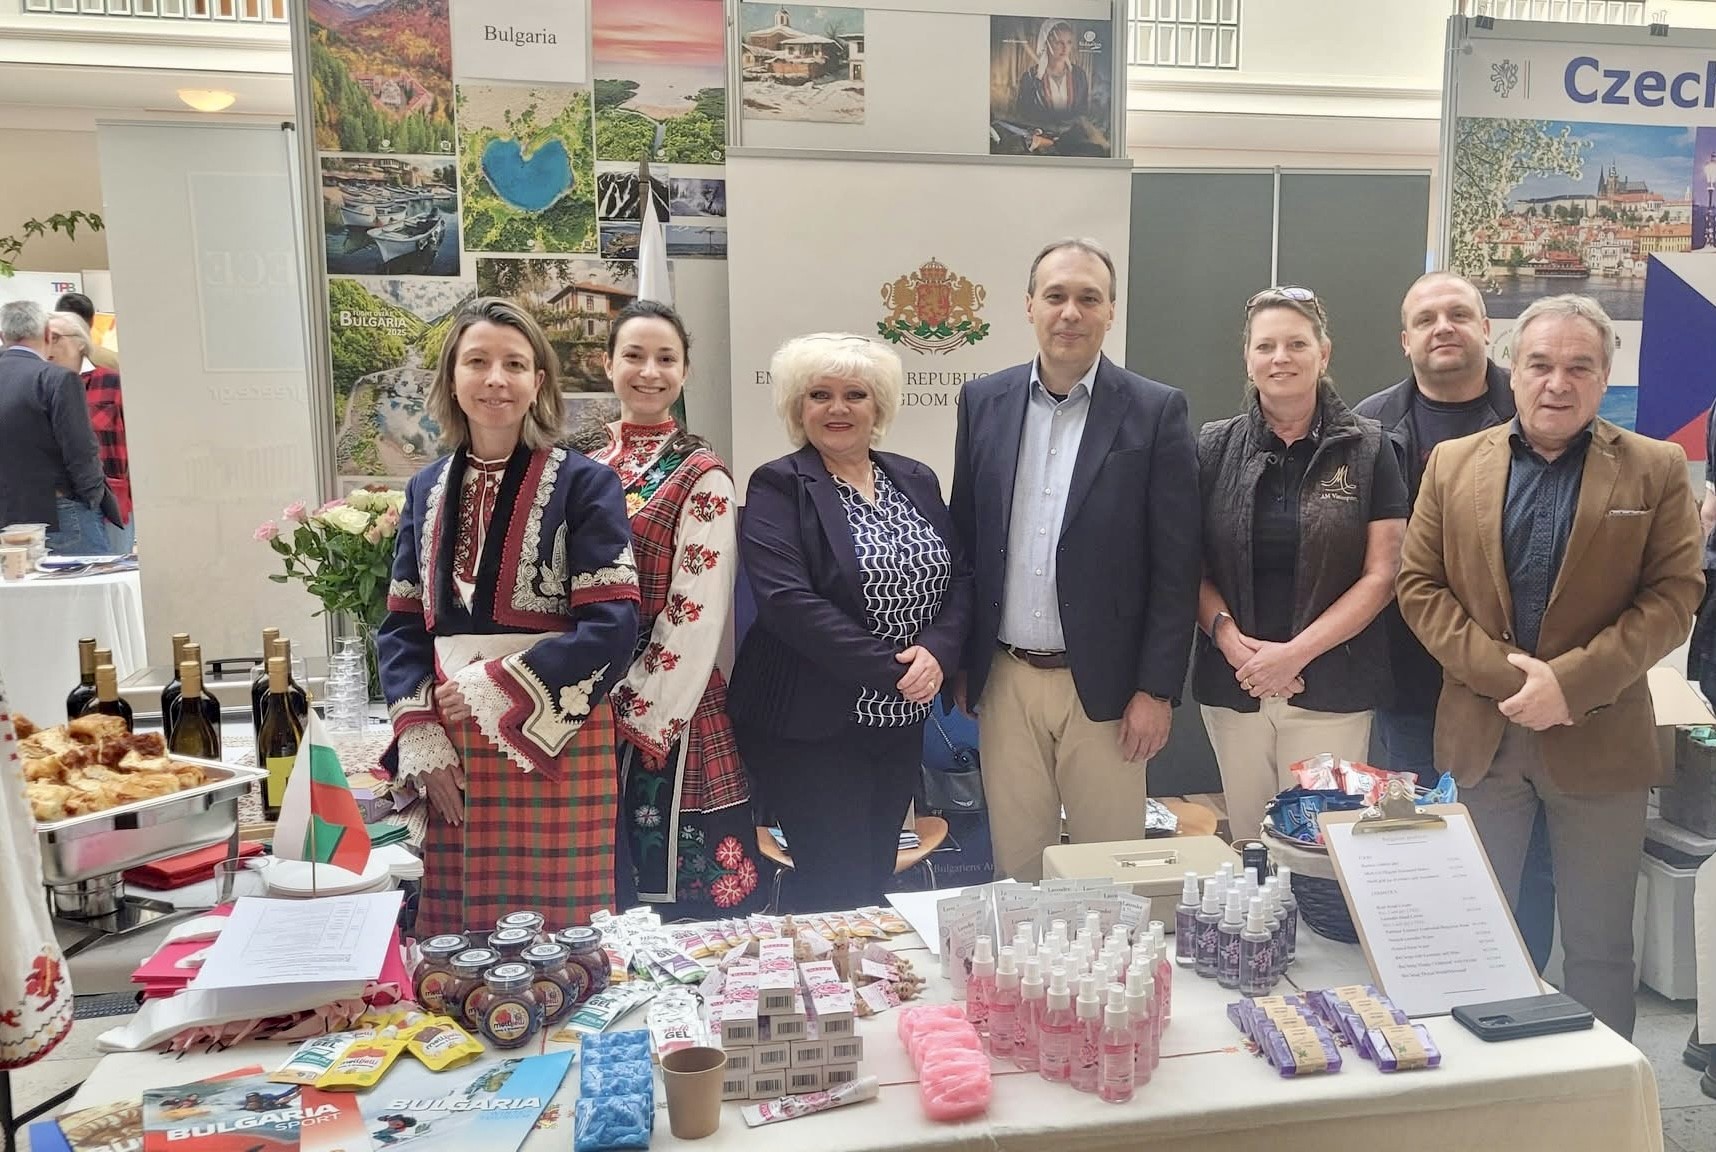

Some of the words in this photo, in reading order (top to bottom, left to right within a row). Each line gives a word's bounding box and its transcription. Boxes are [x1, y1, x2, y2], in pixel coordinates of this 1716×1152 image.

[484, 25, 557, 47] Bulgaria
[50, 282, 76, 293] TPB
[340, 310, 407, 328] BULGARIA
[386, 328, 407, 336] 2025
[589, 999, 610, 1009] GEL
[664, 1031, 692, 1040] GEL
[311, 1039, 336, 1049] GEL
[386, 1097, 541, 1112] BULGARIA
[166, 1103, 340, 1141] BULGARIA
[275, 1112, 342, 1132] SPORT
